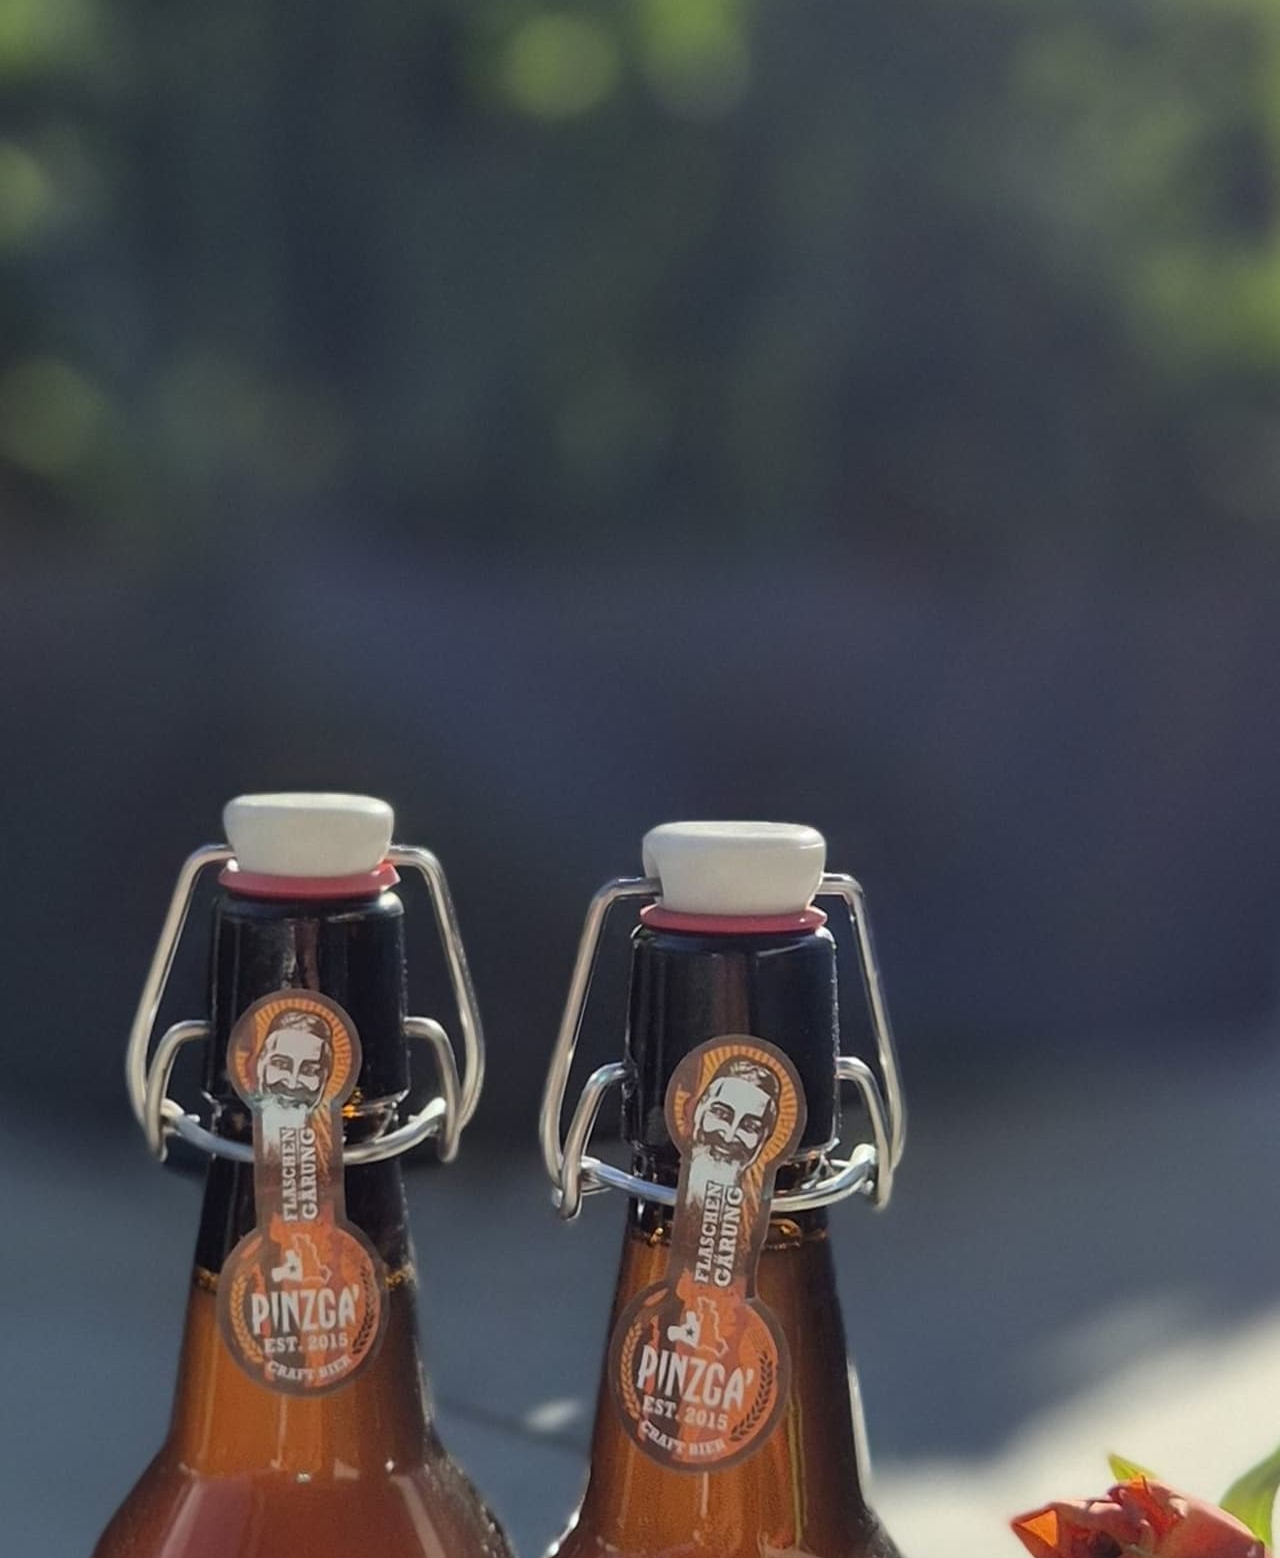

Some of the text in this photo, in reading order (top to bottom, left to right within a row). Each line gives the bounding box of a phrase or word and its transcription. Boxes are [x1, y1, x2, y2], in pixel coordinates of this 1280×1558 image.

[282, 1128, 298, 1221] FLASCHEN
[299, 1128, 318, 1220] GÄRUNG
[695, 1181, 723, 1283] FLASCHEN
[713, 1186, 743, 1287] GÄRUNG
[264, 1332, 348, 1353] EST. 2015
[268, 1354, 353, 1381] CRAFT BIER
[642, 1419, 727, 1456] CRAFT BIER
[643, 1394, 729, 1431] EST. 2015
